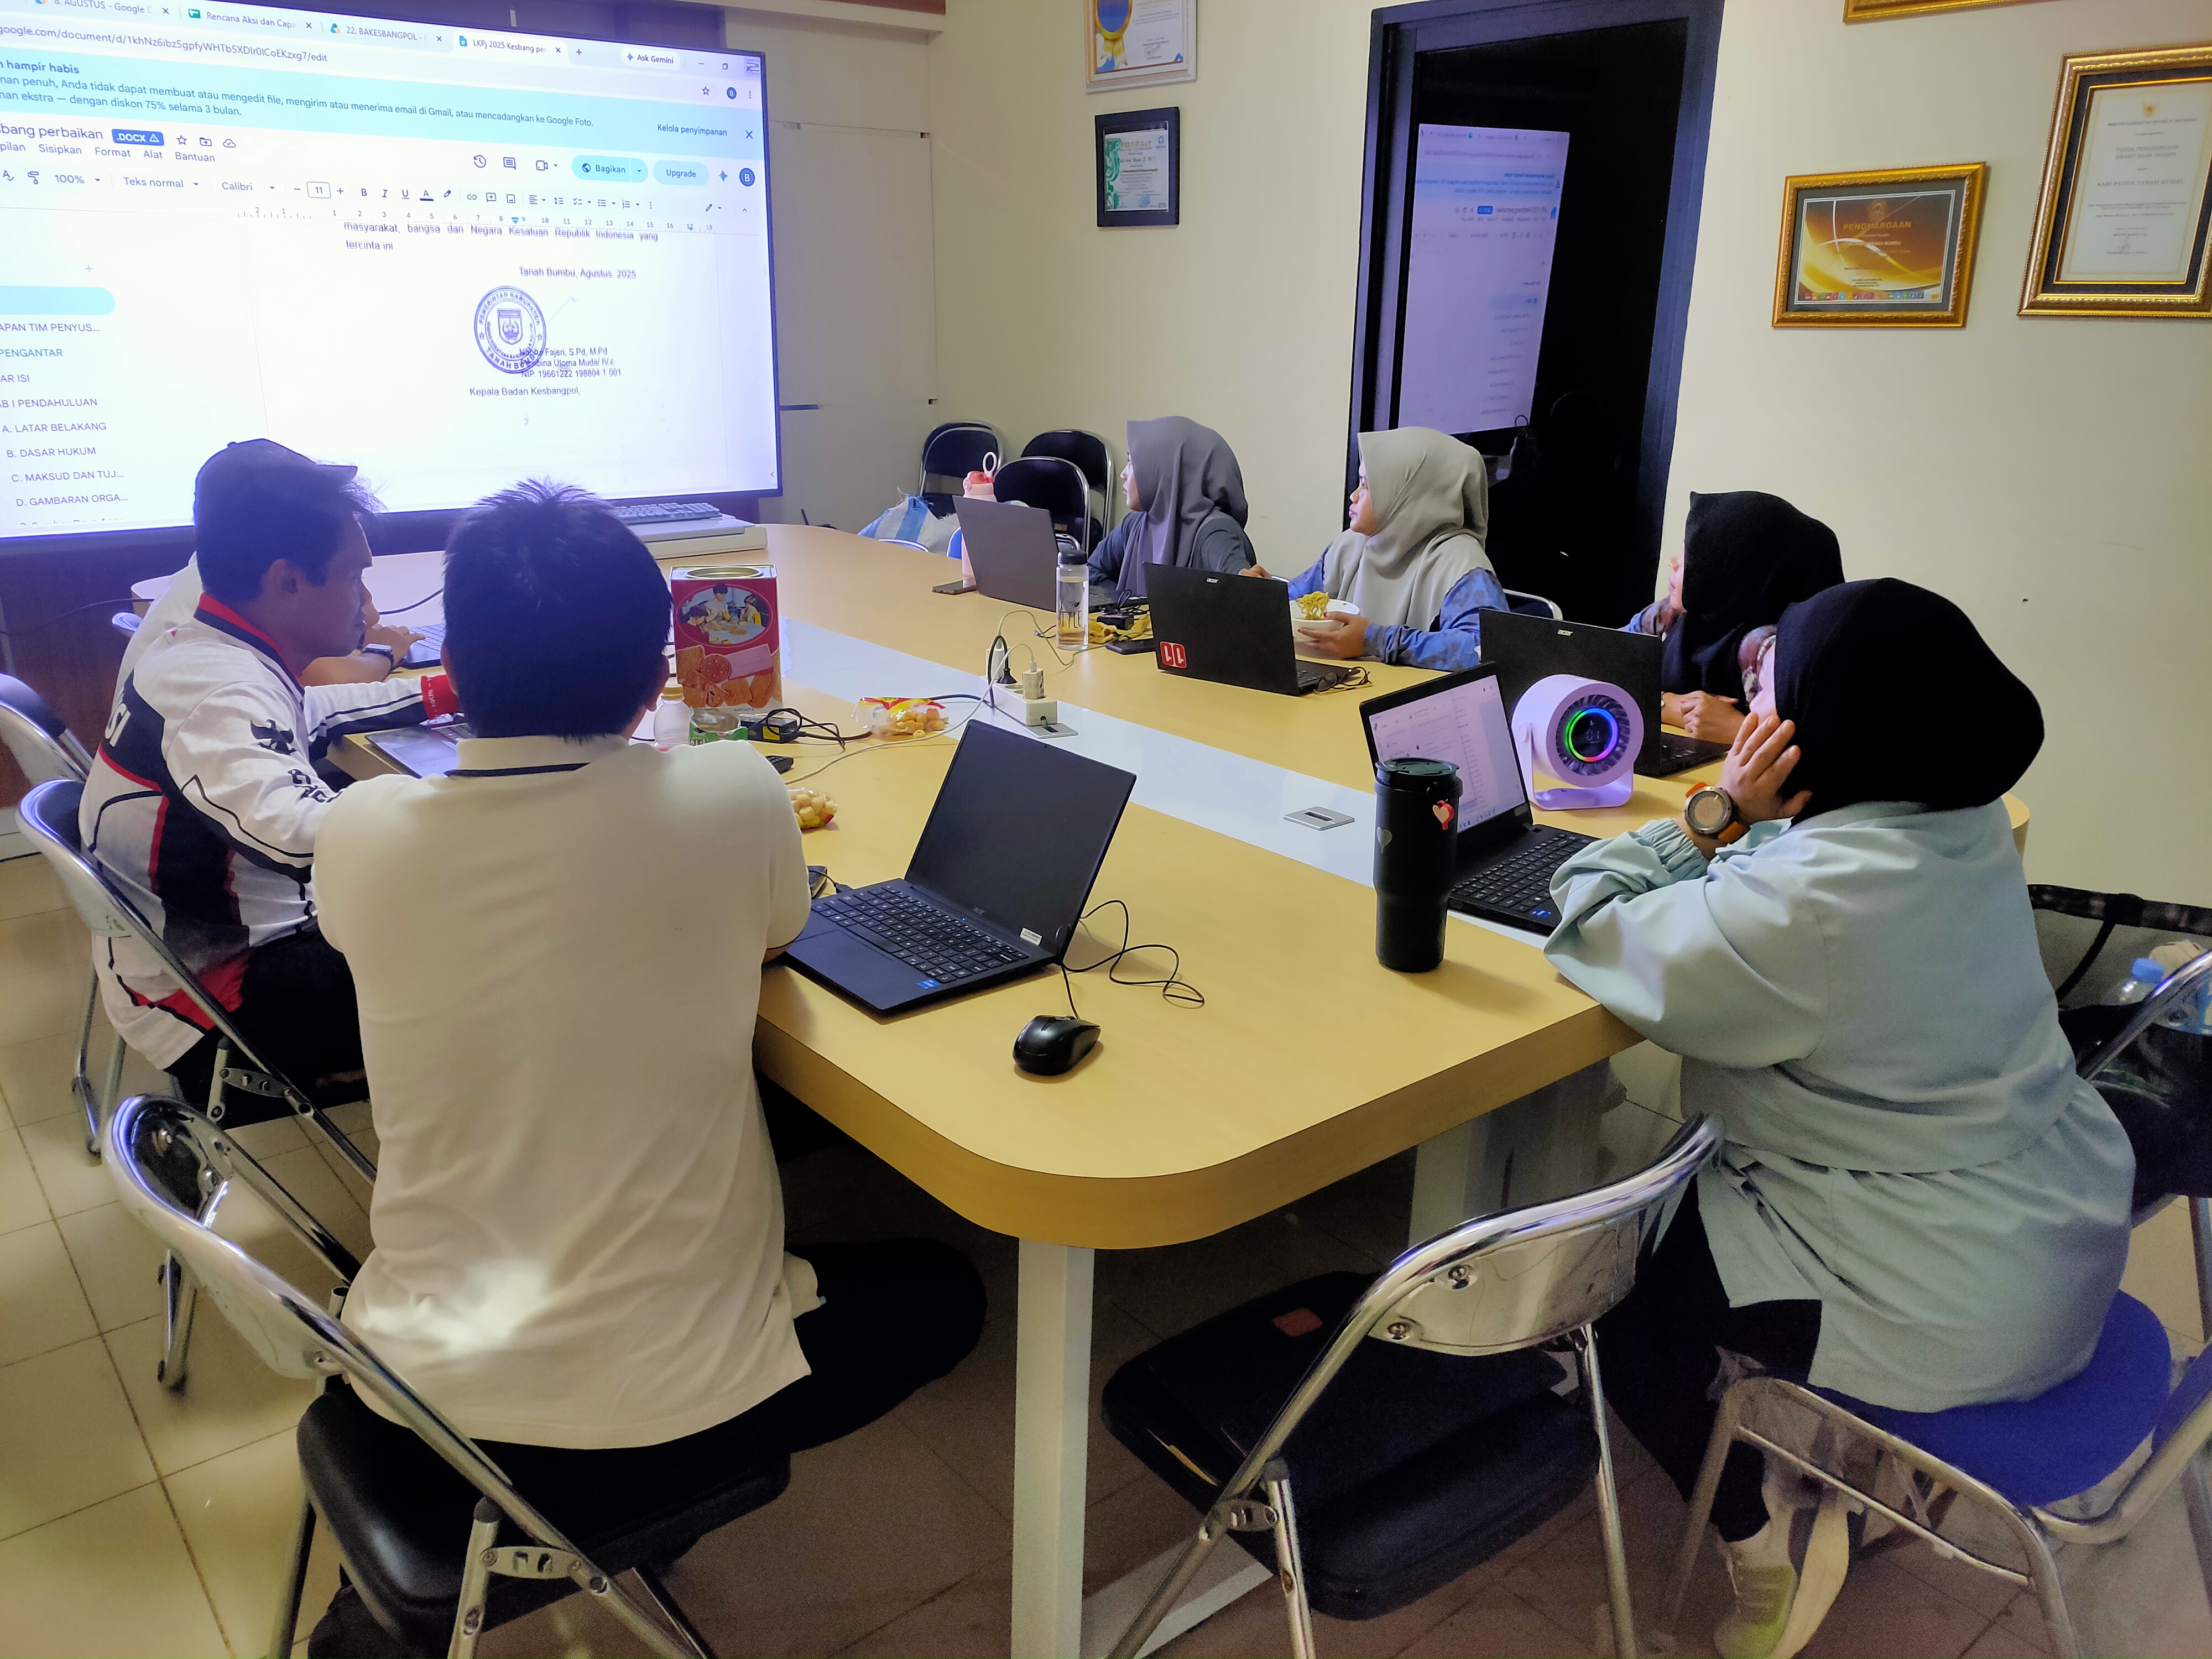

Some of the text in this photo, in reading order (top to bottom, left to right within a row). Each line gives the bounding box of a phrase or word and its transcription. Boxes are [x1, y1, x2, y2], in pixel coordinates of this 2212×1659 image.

[64, 0, 106, 9] AGUSTUS
[114, 3, 145, 14] Google
[206, 12, 239, 22] Rencana
[242, 15, 258, 24] Aksi
[260, 18, 275, 26] dan
[359, 28, 417, 40] BAKESBANGPOL
[473, 39, 487, 49] LKPj
[507, 43, 534, 54] Kesbang
[651, 56, 674, 64] Gemini
[6, 60, 79, 74] hampir habis
[21, 91, 54, 102] ekstra
[69, 95, 108, 107] dengan
[111, 97, 143, 109] diskon
[145, 101, 166, 110] 75%
[169, 103, 202, 113] selama
[213, 105, 242, 116] bulan.
[23, 77, 58, 88] penuh,
[61, 80, 87, 90] Anda
[90, 81, 115, 92] tidak
[118, 84, 147, 95] dapat
[149, 87, 195, 98] membuat
[198, 91, 218, 100] atau
[222, 93, 265, 104] mengedit
[267, 95, 283, 106] file,
[286, 98, 327, 108] mengirim
[330, 101, 349, 109] atau
[351, 103, 393, 112] menerima
[395, 106, 417, 114] email
[419, 106, 427, 114] di
[429, 108, 453, 118] Gmail,
[475, 112, 534, 123] mencadangkan
[546, 116, 573, 127] Google
[576, 118, 594, 127] Foto.
[0, 123, 103, 139] bang perbaikan
[657, 123, 727, 137] Kelola penyimpanan
[0, 142, 215, 161] pilan Sisipkan Format Alat Bantuan
[595, 164, 626, 175] Bagikan
[666, 169, 696, 179] Upgrade
[54, 174, 85, 184] 100%
[123, 177, 184, 188] Teks normal
[222, 181, 253, 191] Calibri
[1843, 221, 1911, 230] PENGHARGAAN
[344, 222, 658, 242] masyarakat, bangsa dan Negara Kesatuan Republik Indonesia yang
[346, 239, 393, 250] tercinta ini
[518, 267, 637, 279] Tanah Bumbu, Agustus 2025
[486, 346, 511, 369] TANAH
[545, 348, 567, 357] Fajeri,
[603, 368, 606, 377] 1
[469, 386, 581, 397] Kepala Badan Kesbangpol,
[18, 398, 98, 408] PENDAHULUAN
[15, 424, 48, 432] LATAR
[51, 422, 107, 431] BELAKANG
[20, 448, 55, 457] DASAR
[58, 447, 96, 456] HUKUM
[25, 472, 70, 482] MAKSUD
[73, 471, 95, 479] DAN
[29, 495, 88, 505] GAMBARAN
